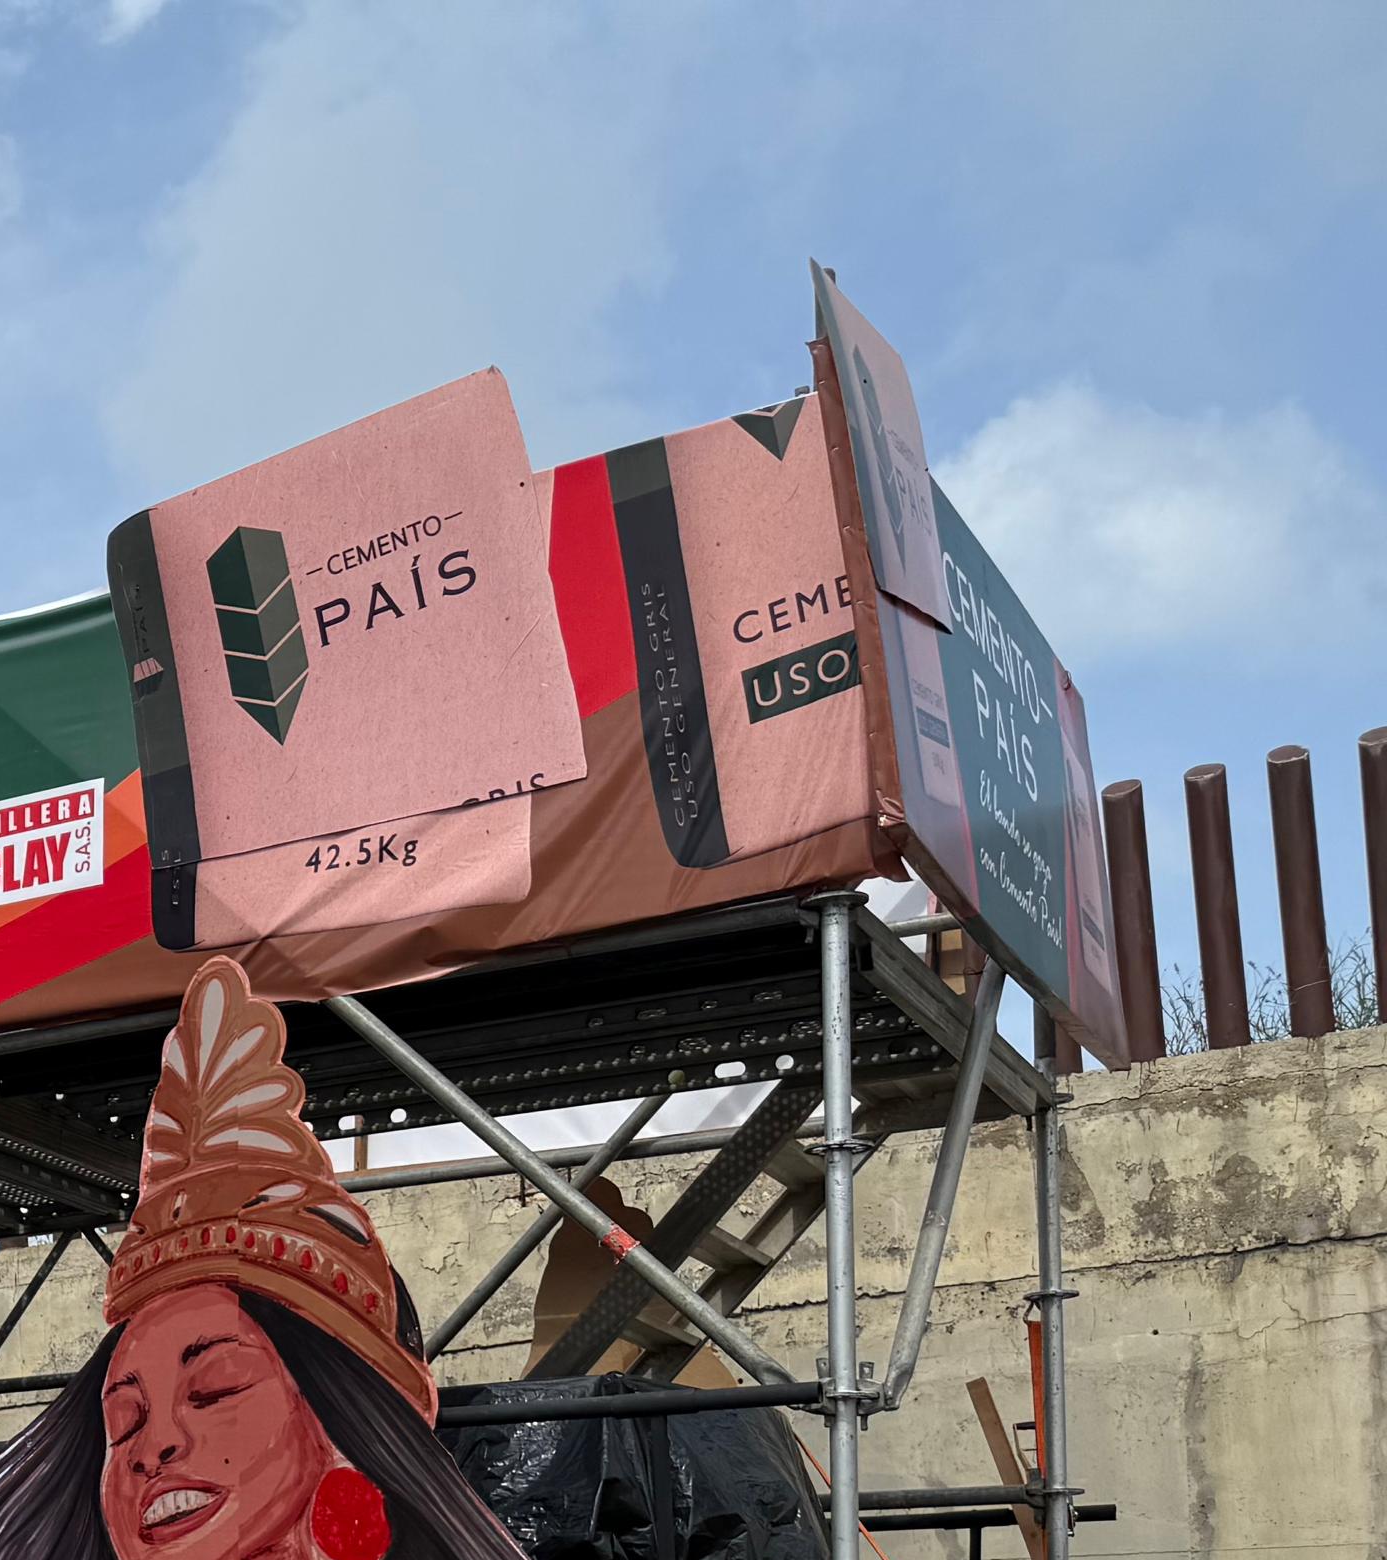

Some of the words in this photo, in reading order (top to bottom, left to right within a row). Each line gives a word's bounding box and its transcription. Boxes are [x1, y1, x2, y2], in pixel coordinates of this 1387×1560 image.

[327, 515, 442, 576] CEMENTO
[314, 549, 477, 648] PAÍS
[641, 583, 659, 652] GRIS
[657, 586, 686, 733] GENERAL
[942, 551, 1040, 725] CEMENTO
[753, 649, 850, 707] USO
[655, 669, 684, 827] CEMENTO
[972, 668, 1038, 802] PAÍS
[682, 752, 698, 819] USO
[75, 821, 92, 873] S.A.S.
[304, 833, 419, 874] 42.5Kg
